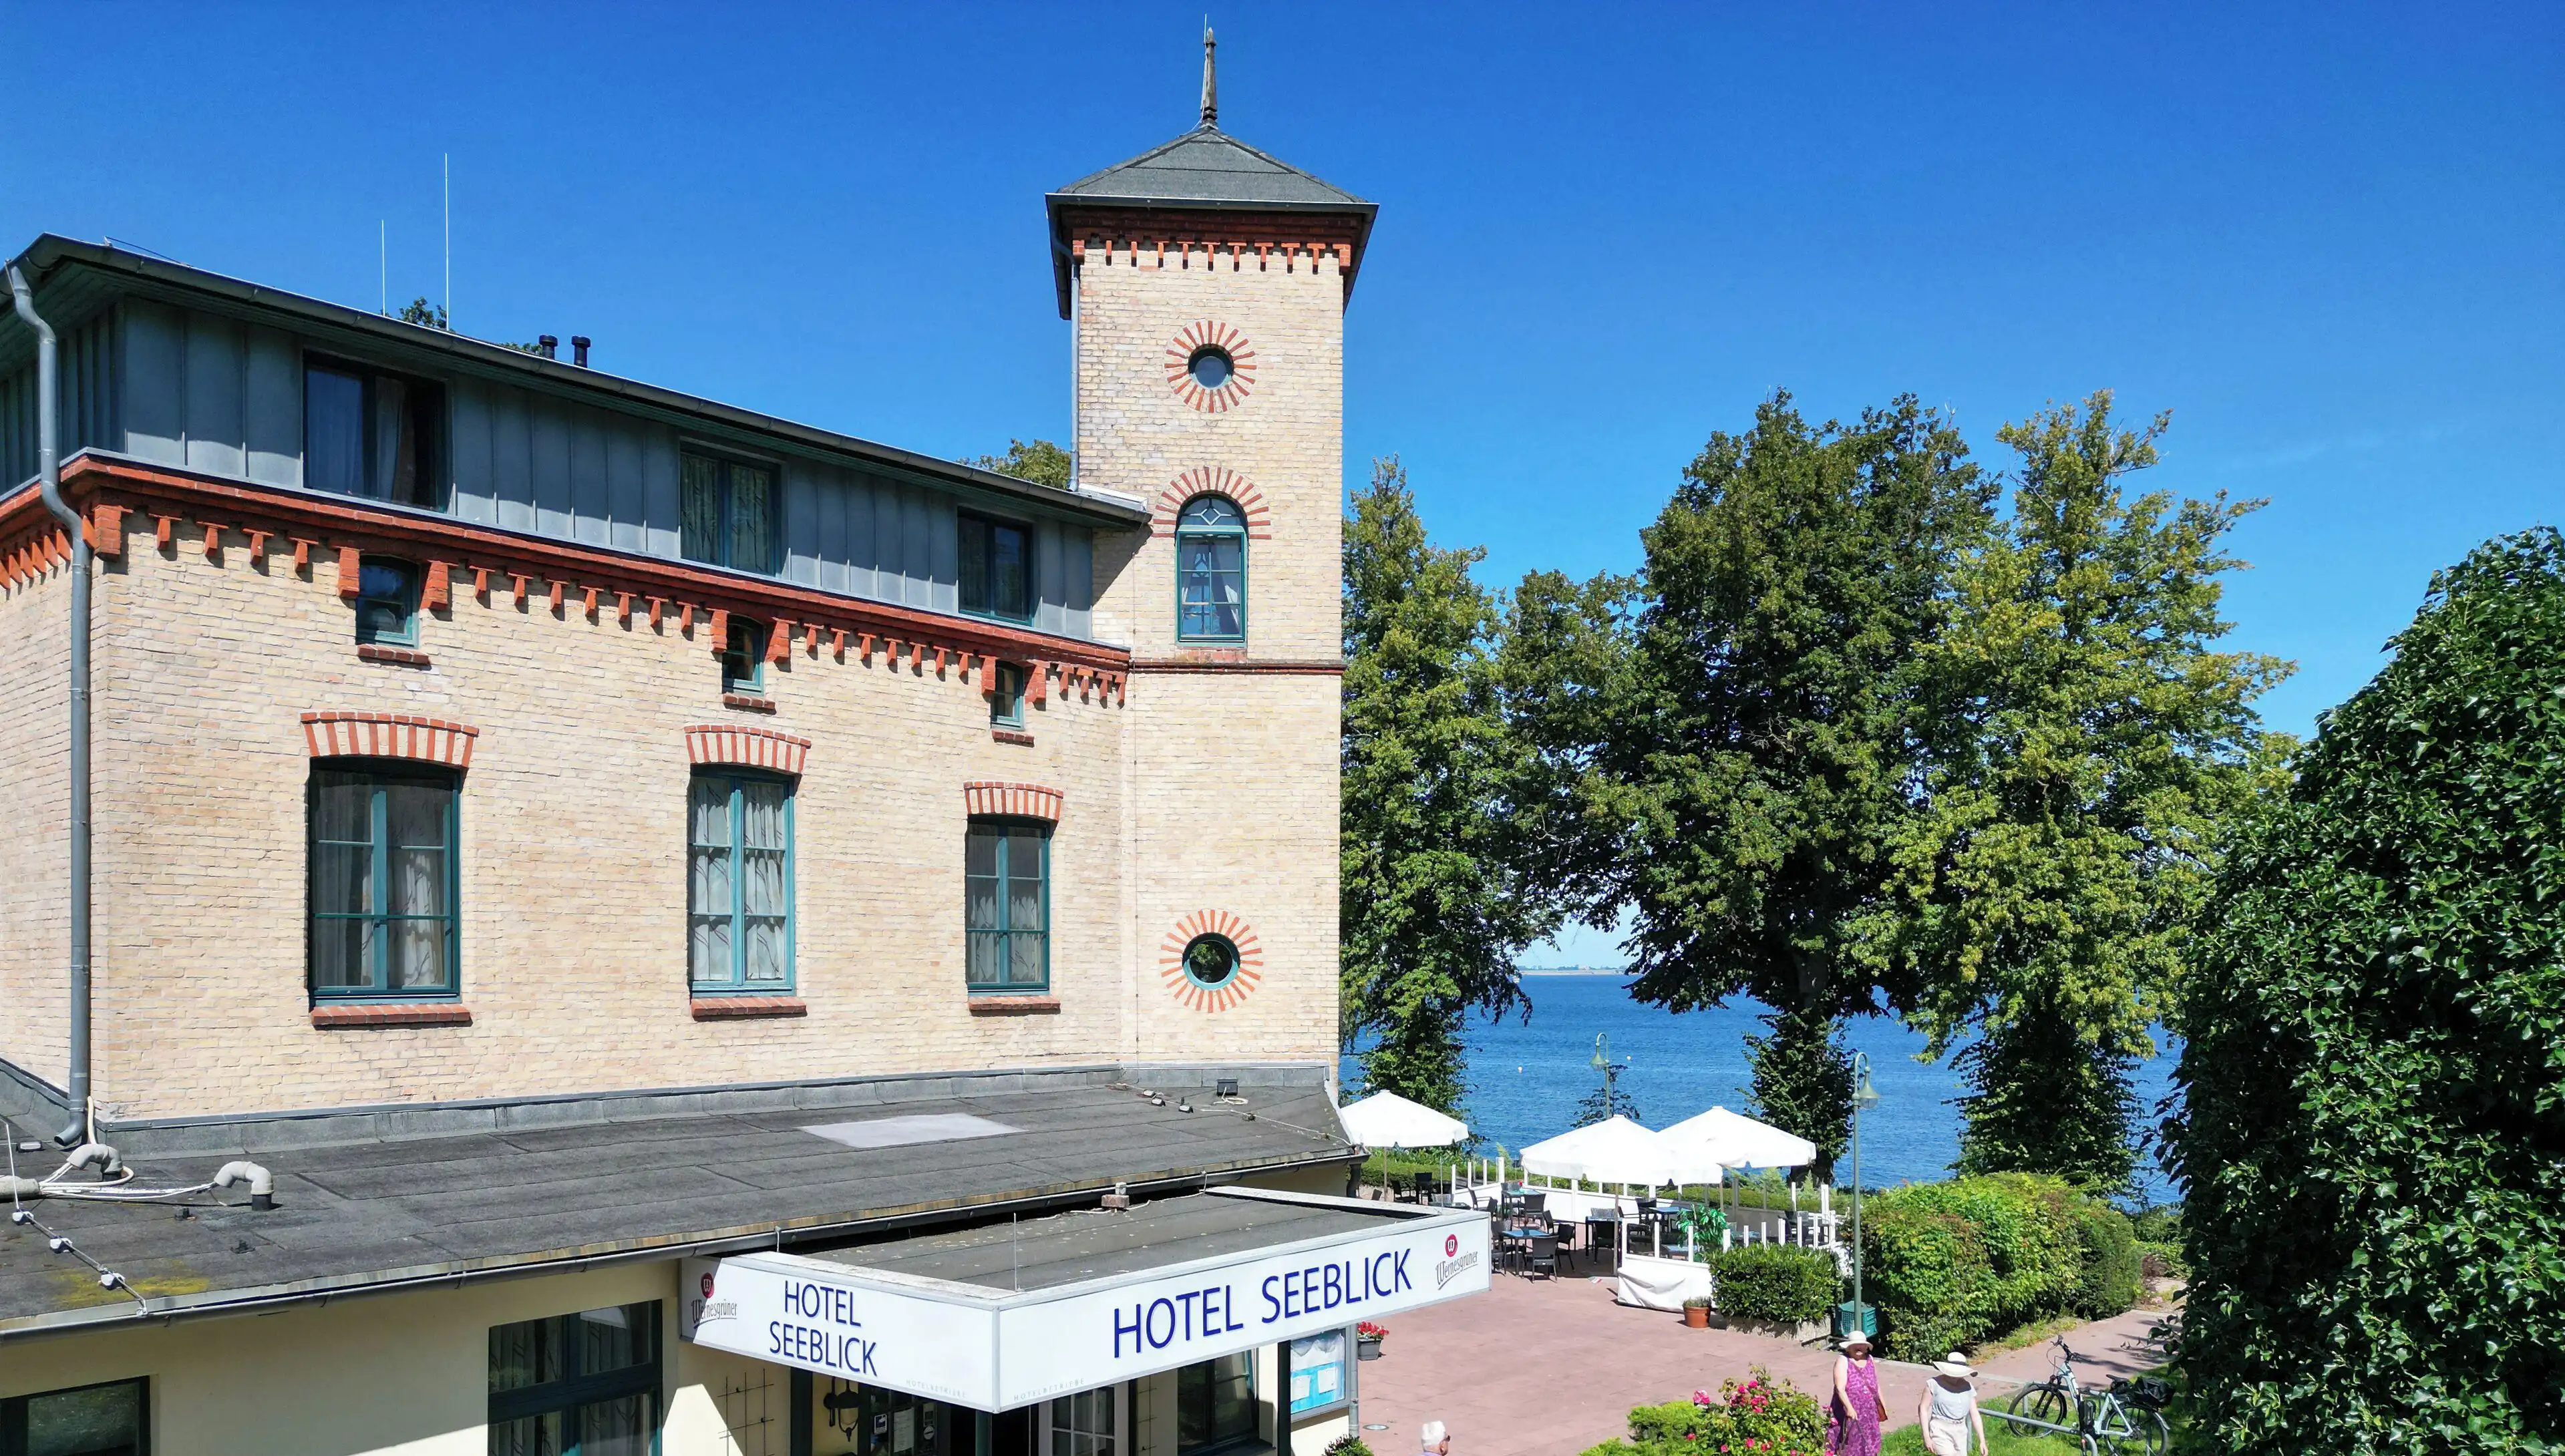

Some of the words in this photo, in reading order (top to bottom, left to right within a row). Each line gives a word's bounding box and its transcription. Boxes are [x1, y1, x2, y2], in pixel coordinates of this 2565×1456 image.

[691, 1298, 737, 1325] Wernesgrüner
[784, 1280, 862, 1327] HOTEL
[1114, 1284, 1244, 1358] HOTEL
[1261, 1248, 1412, 1324] SEEBLICK
[769, 1320, 878, 1377] SEEBLICK
